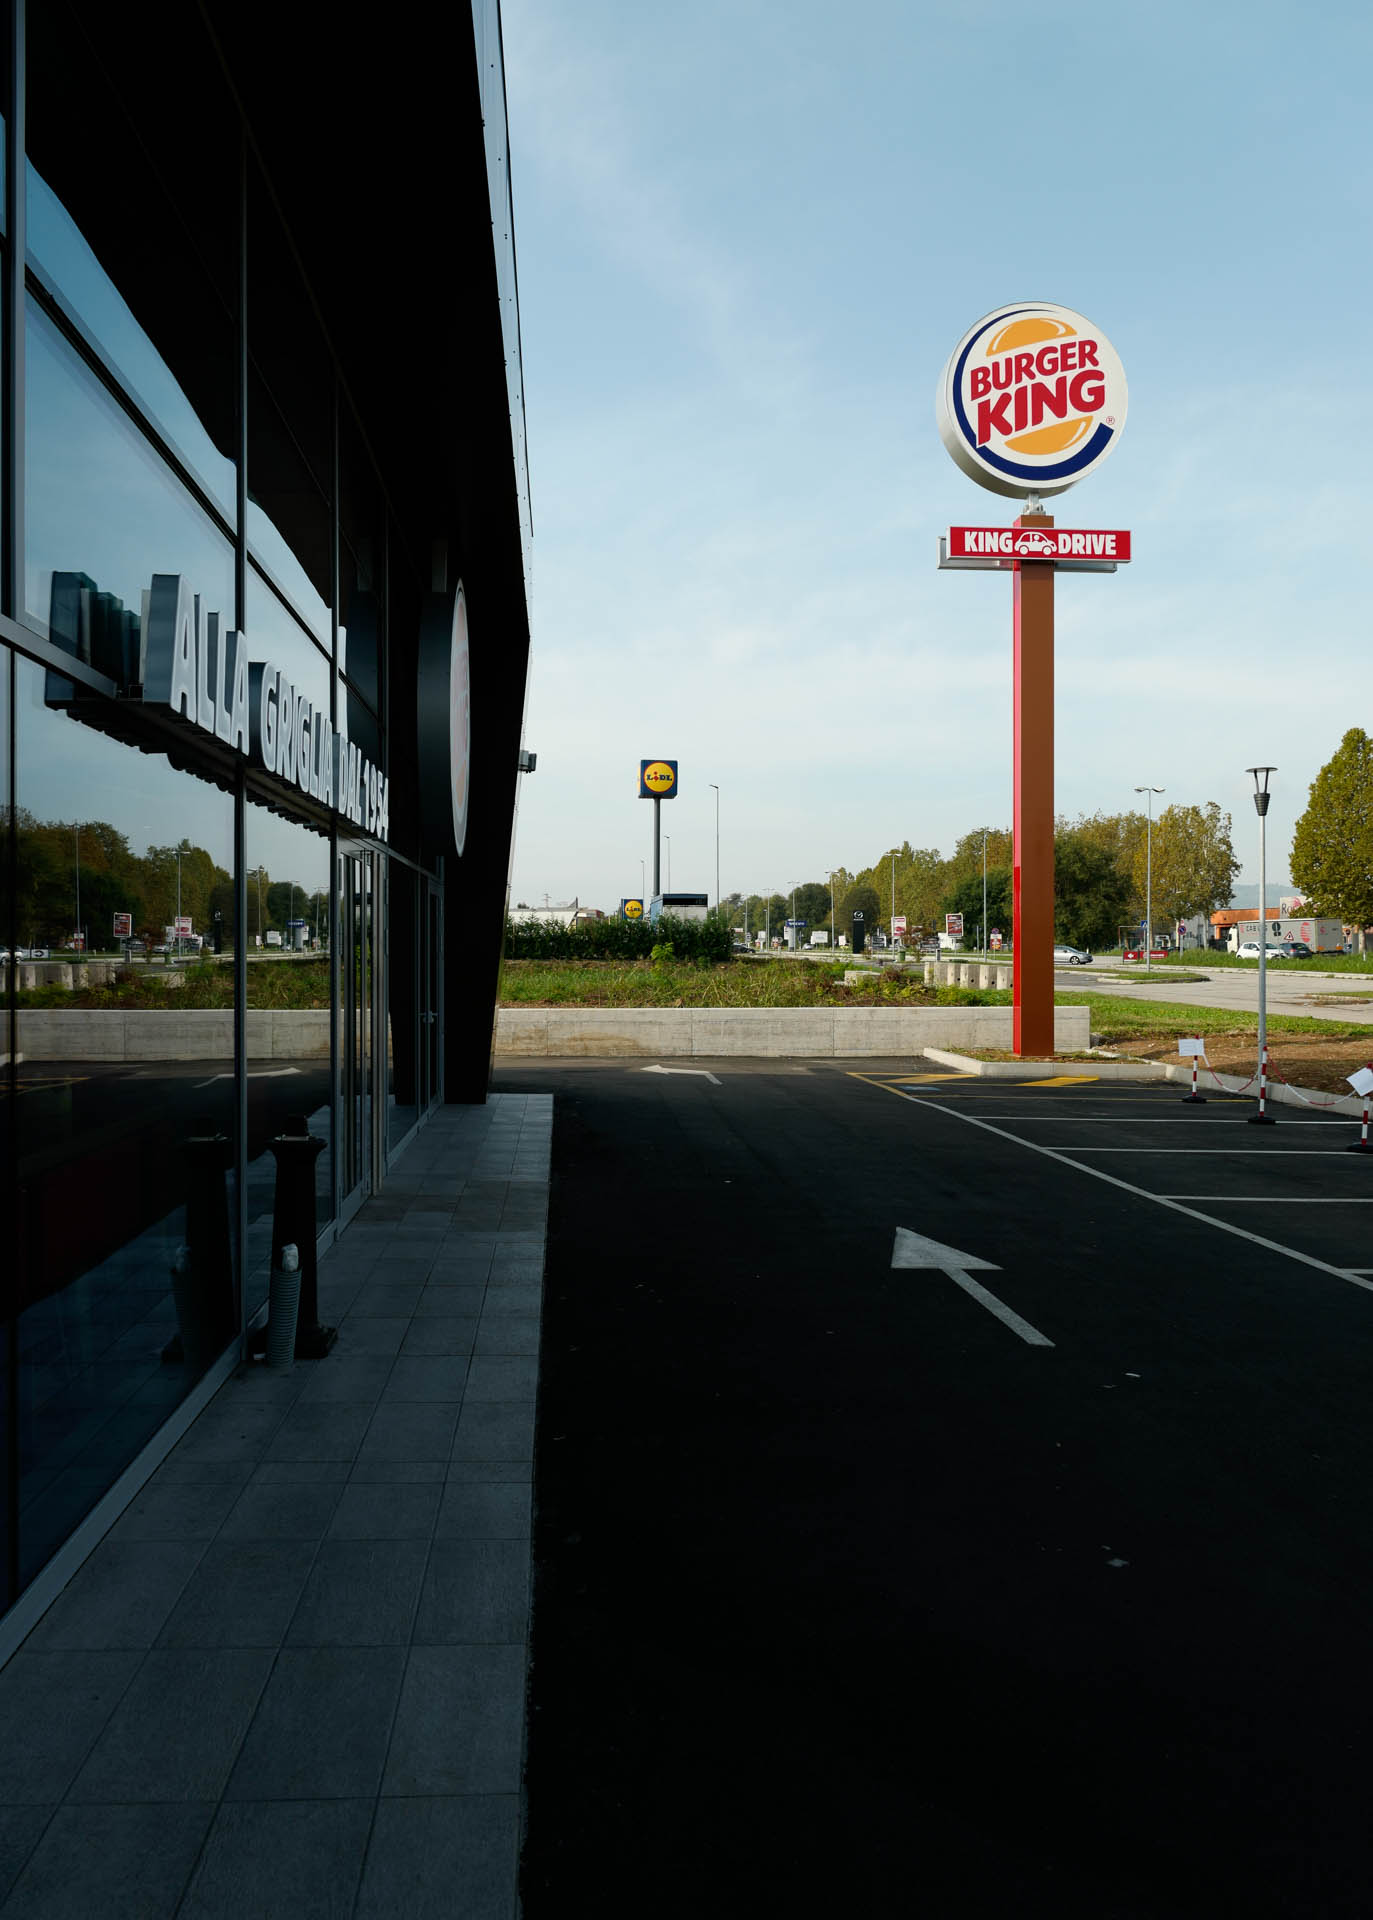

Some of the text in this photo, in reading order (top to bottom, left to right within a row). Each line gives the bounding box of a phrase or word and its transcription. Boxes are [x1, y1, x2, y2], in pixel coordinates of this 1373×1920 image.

[970, 339, 1099, 401] BURGER
[977, 369, 1106, 447] KING
[964, 531, 1117, 555] KING DRIVE
[170, 574, 250, 756] ALLA
[260, 661, 334, 809] GRIGLIA
[338, 739, 362, 827] DAL
[364, 758, 389, 843] 1954
